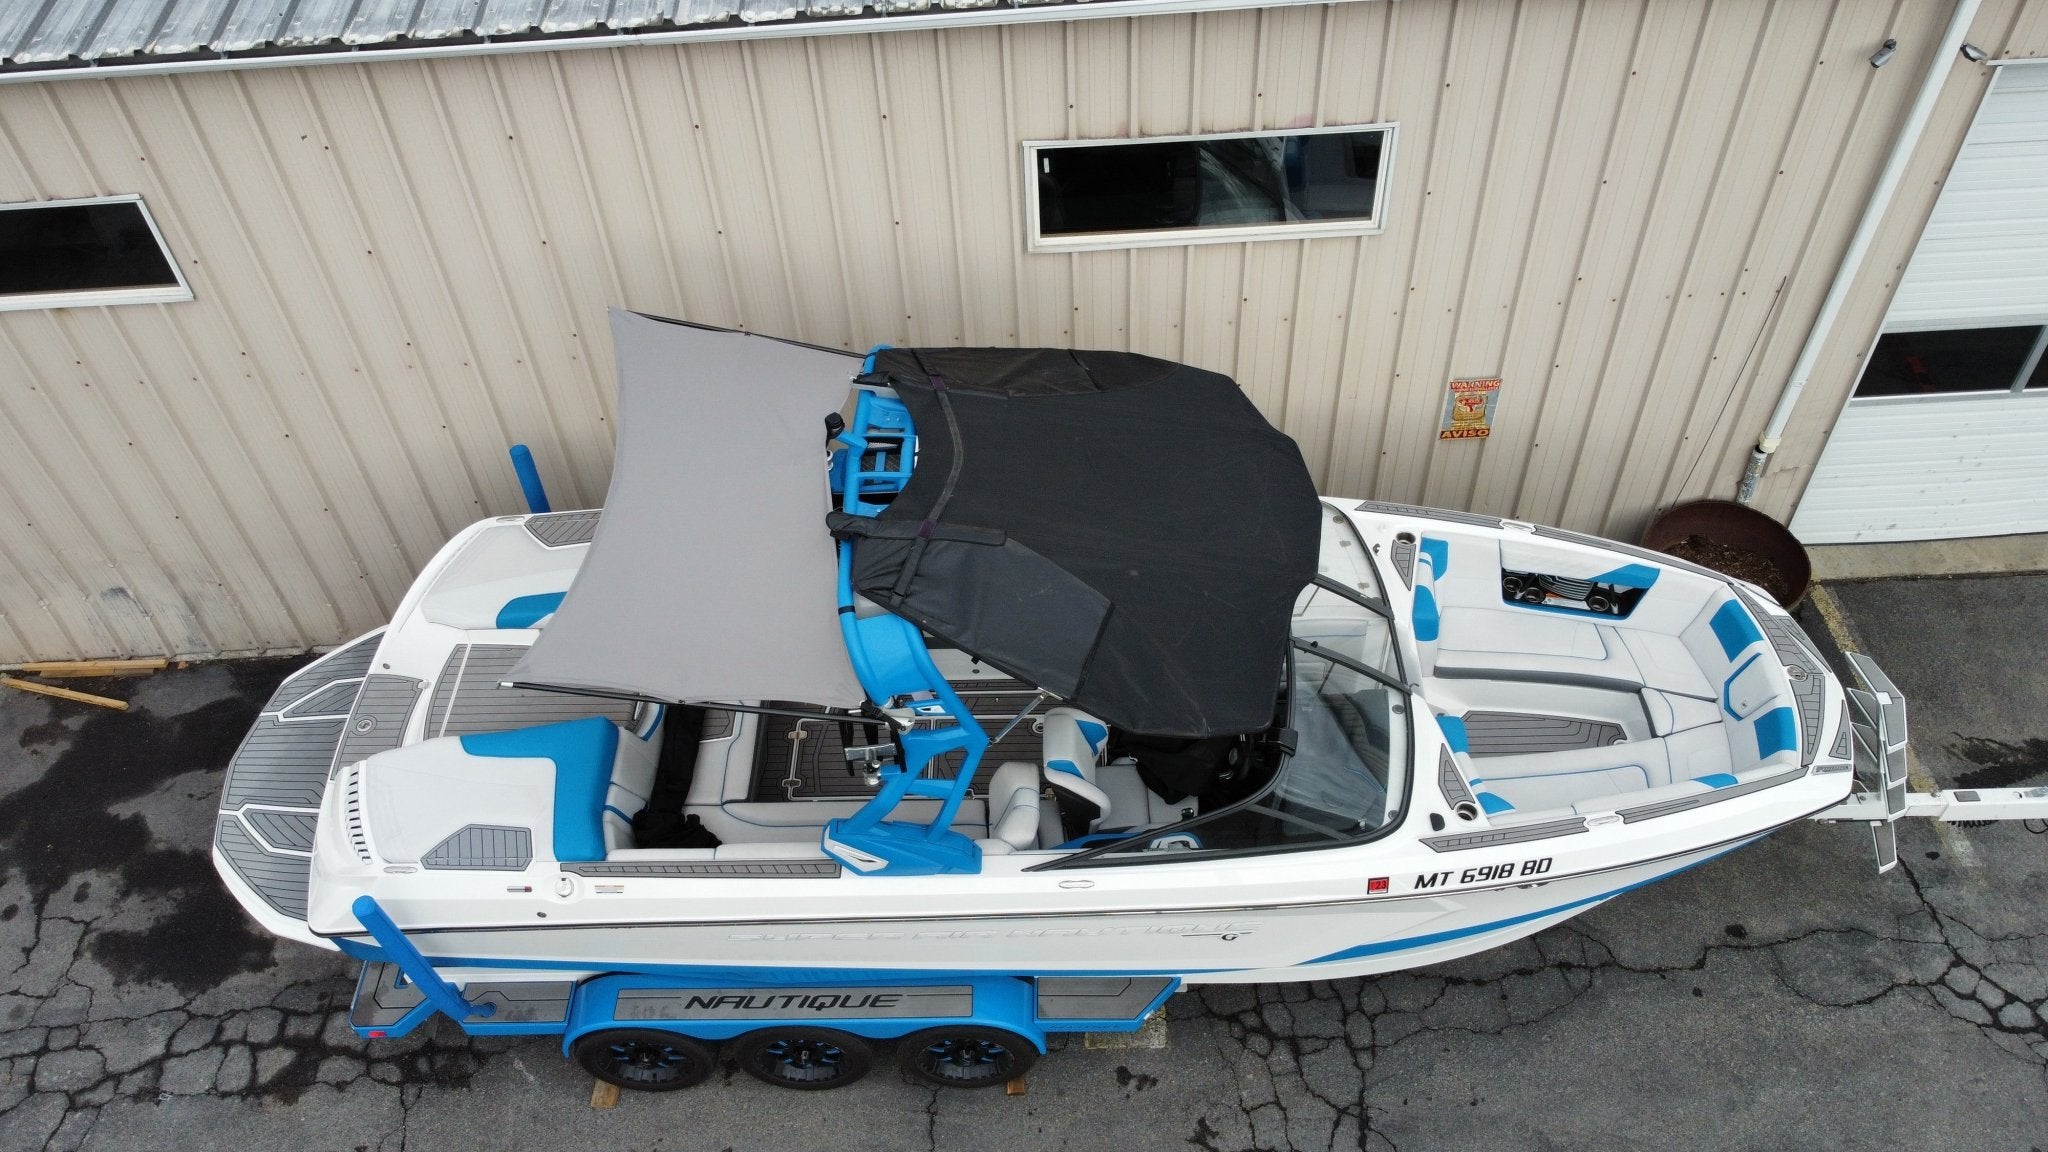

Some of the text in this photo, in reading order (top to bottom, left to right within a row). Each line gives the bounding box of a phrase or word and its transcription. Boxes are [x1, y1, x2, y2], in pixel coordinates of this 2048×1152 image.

[1451, 380, 1501, 389] WARNING
[1441, 429, 1489, 438] AVISO
[1414, 857, 1553, 890] MT 6918 BD
[683, 993, 905, 1012] NAUTIQUE
